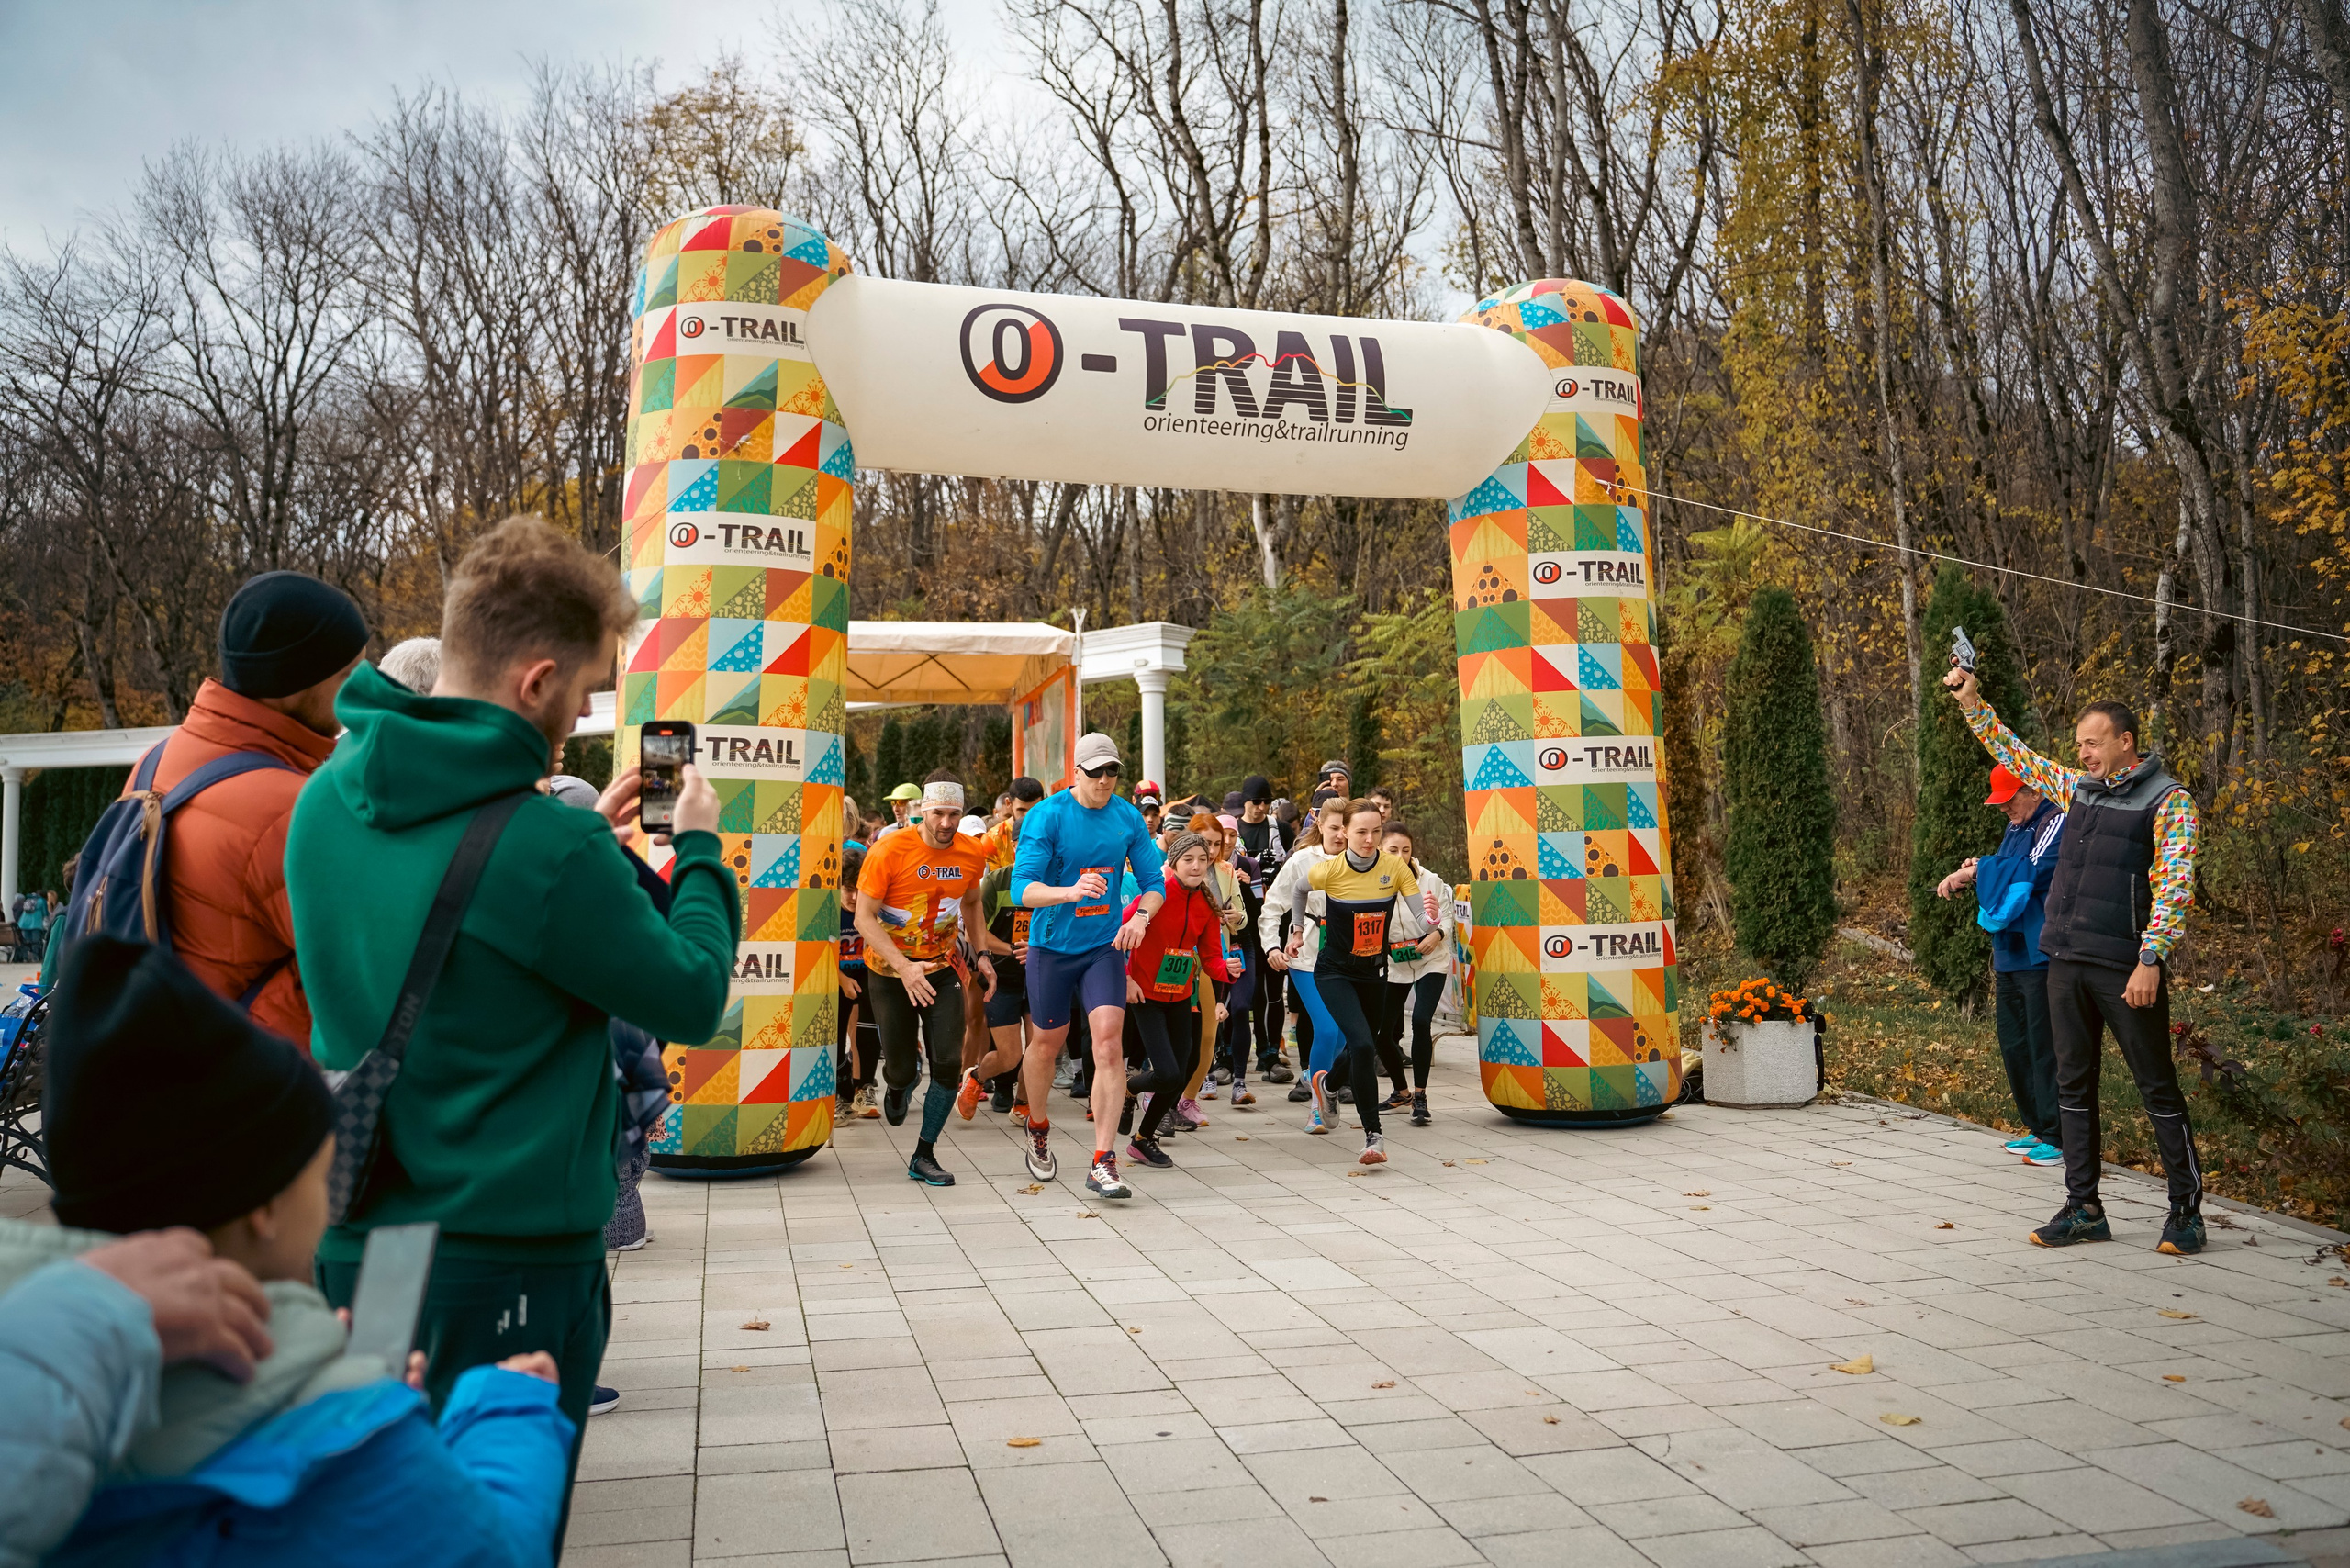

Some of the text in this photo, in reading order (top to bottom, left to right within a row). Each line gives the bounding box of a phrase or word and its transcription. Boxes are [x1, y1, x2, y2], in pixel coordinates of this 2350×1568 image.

[727, 337, 805, 350] orienteering&trailrunning
[1143, 412, 1409, 451] orienteering&trailrunning
[723, 548, 811, 561] orienteering&trailrunning
[711, 761, 800, 770] orienteering&trailrunning
[1357, 919, 1382, 937] 1317
[1396, 948, 1418, 963] 315
[1164, 957, 1190, 975] 301
